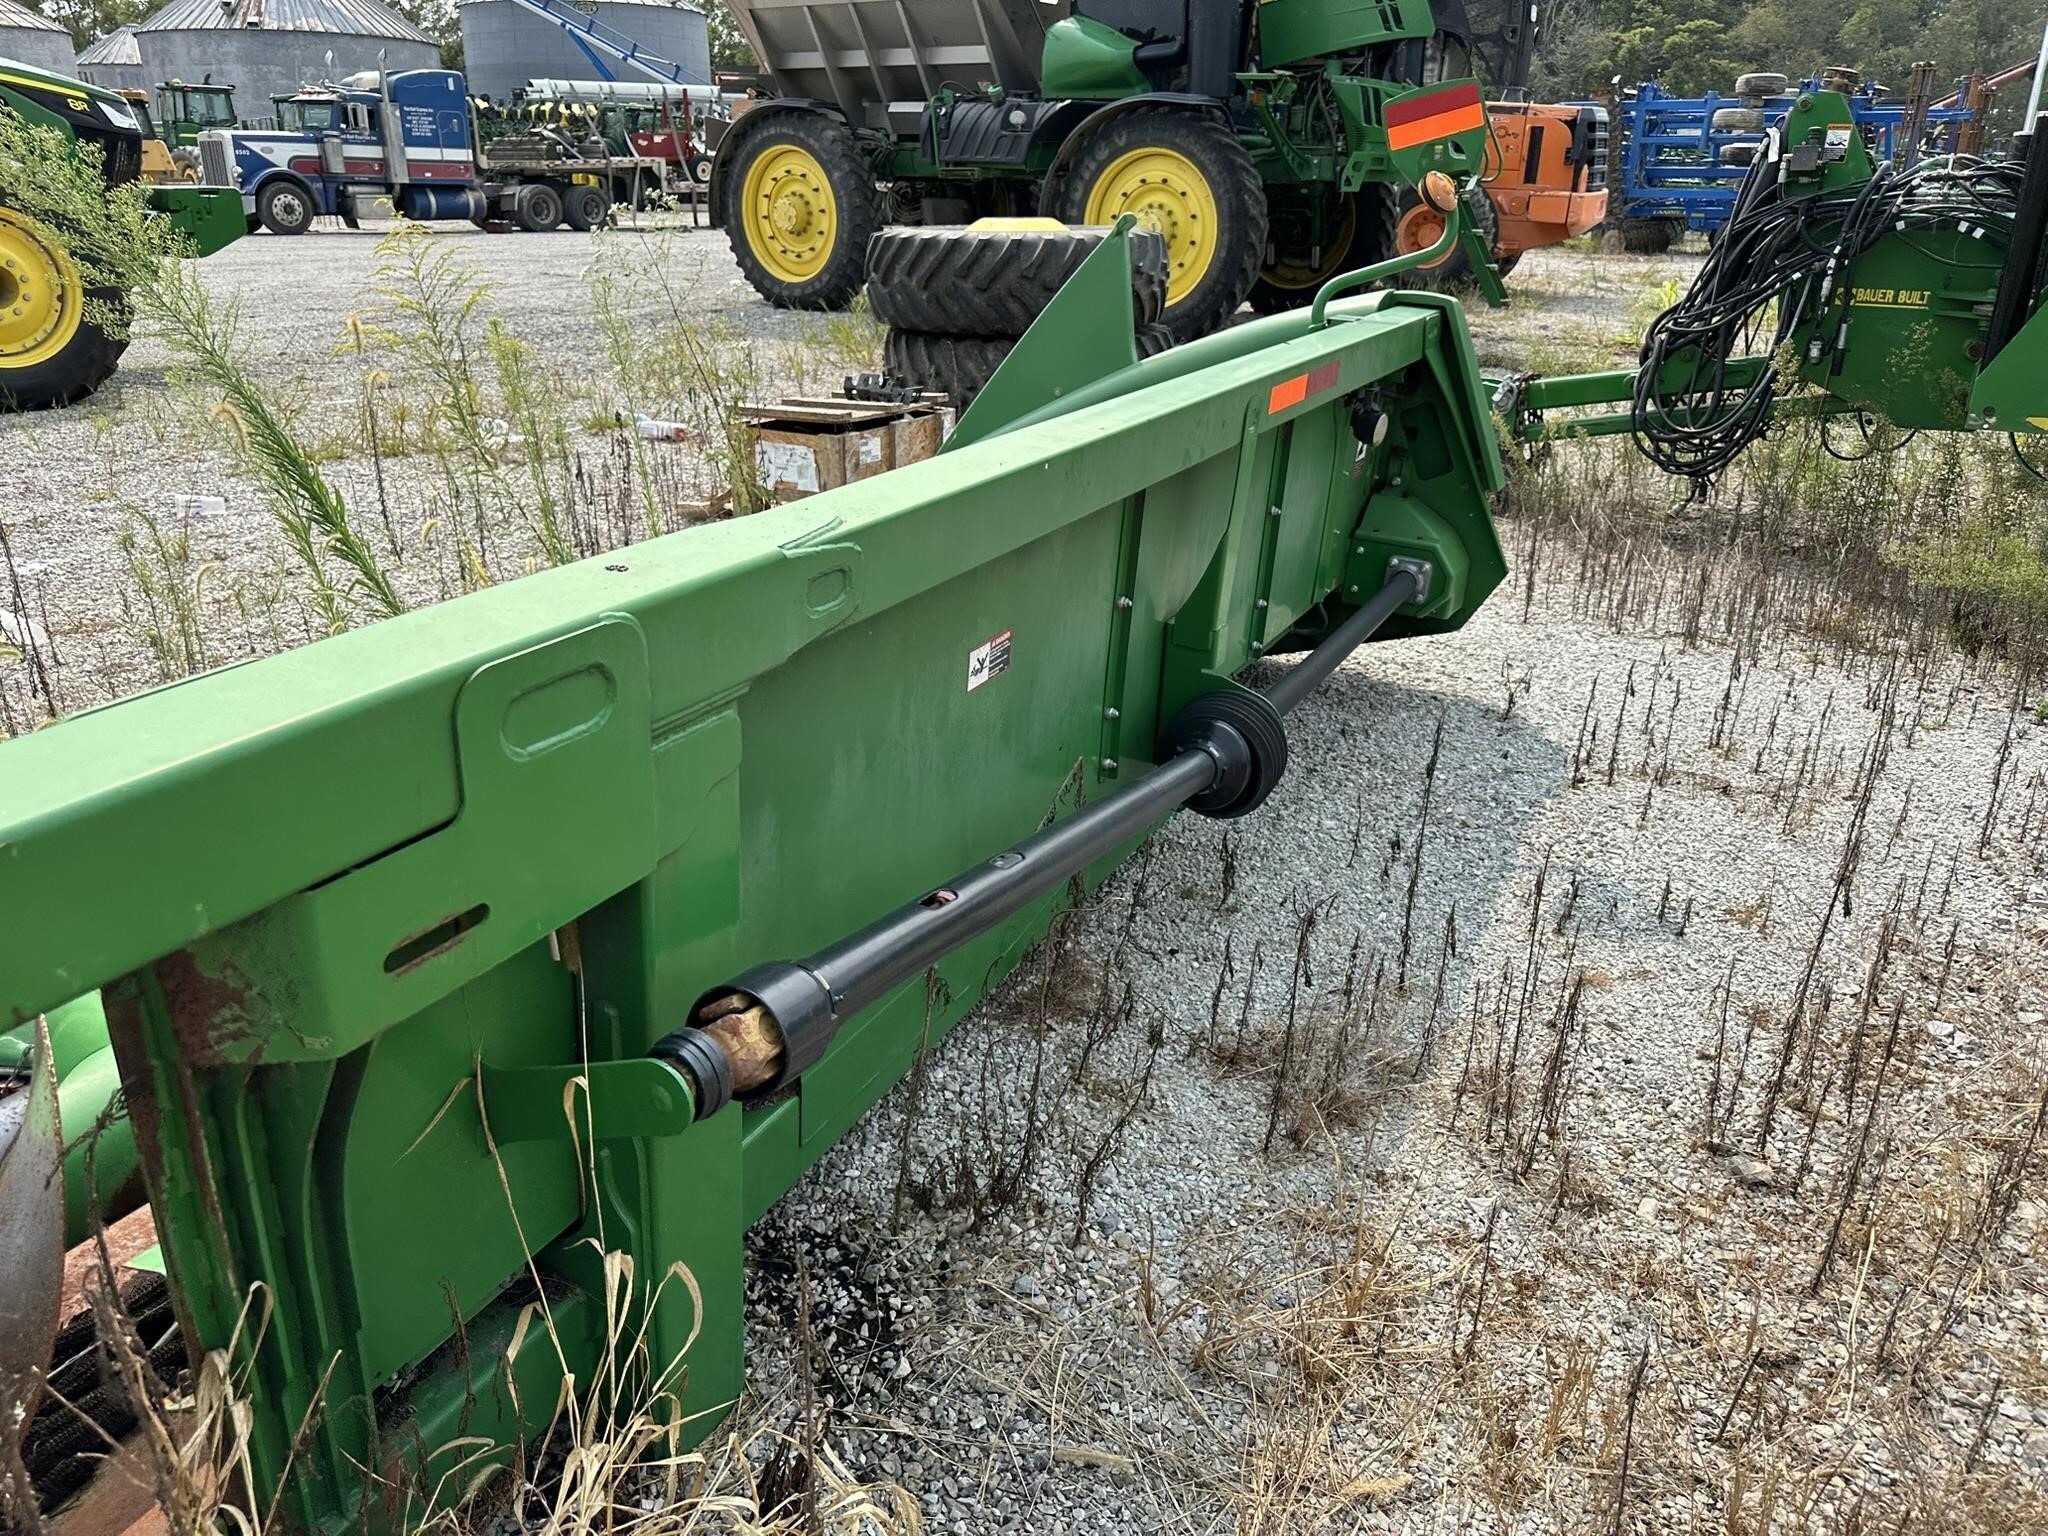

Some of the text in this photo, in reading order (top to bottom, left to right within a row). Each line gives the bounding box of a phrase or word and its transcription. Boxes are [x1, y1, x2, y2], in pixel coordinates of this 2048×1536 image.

[66, 98, 90, 112] 8R
[1856, 288, 1931, 305] BAUER BUILT
